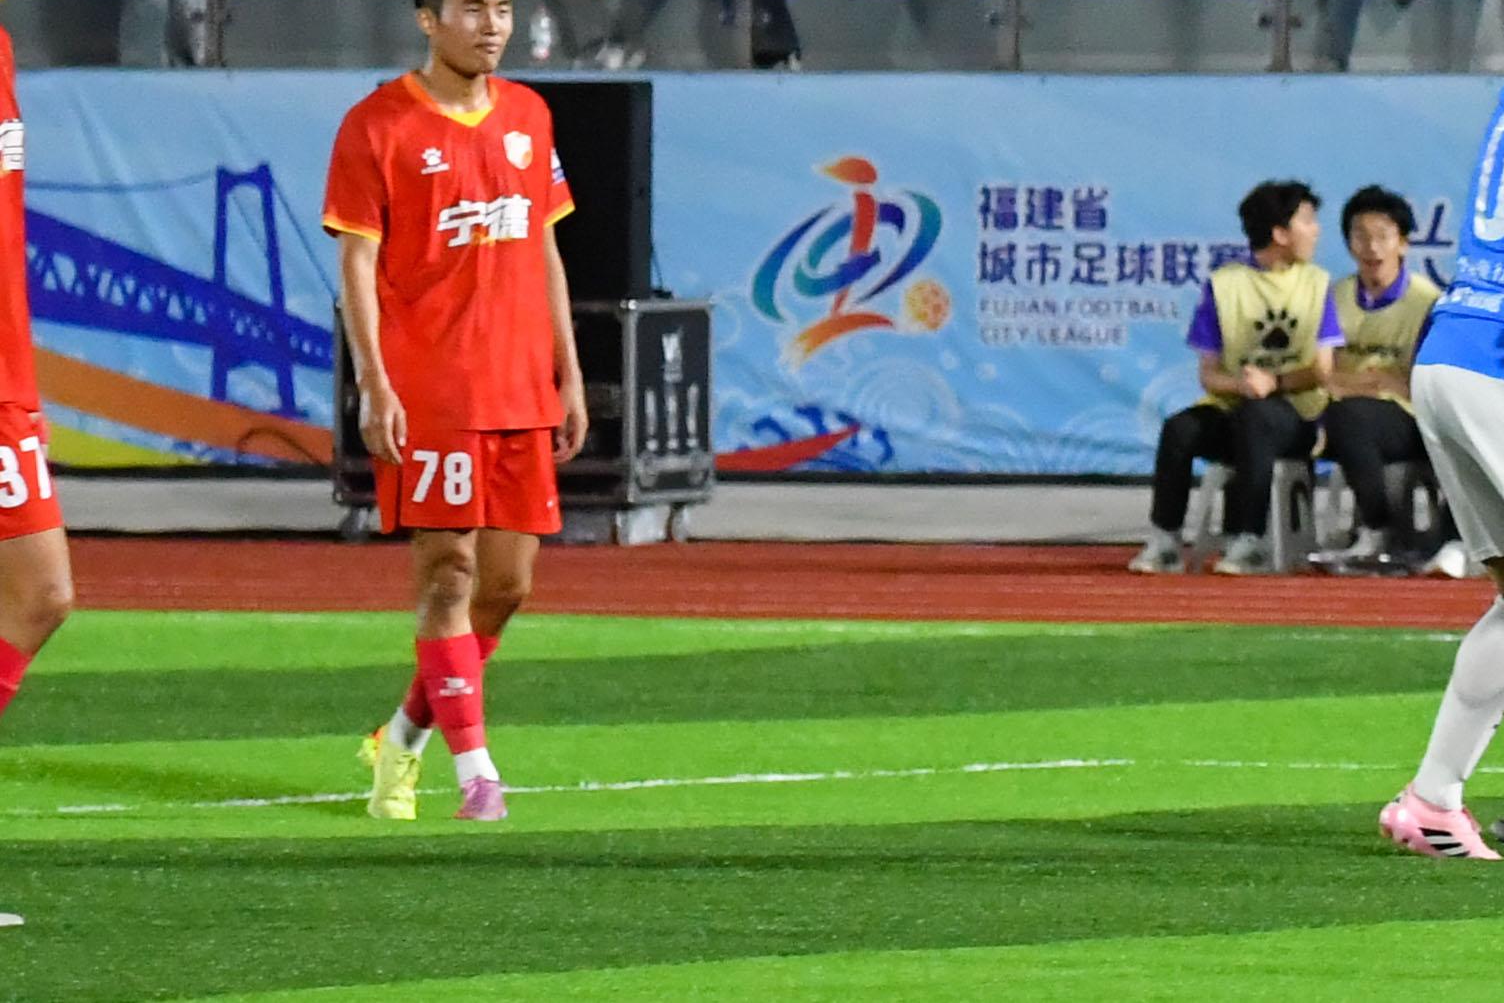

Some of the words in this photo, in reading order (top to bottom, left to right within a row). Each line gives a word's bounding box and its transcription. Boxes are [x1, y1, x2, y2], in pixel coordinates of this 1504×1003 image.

[436, 193, 532, 247] 宁德
[979, 186, 1109, 230] 福建省
[979, 299, 1057, 317] FUJIAN
[1064, 299, 1179, 318] FOOTBALL
[980, 325, 1028, 344] CITY
[1037, 325, 1122, 345] LEAGUE
[411, 450, 472, 505] 78
